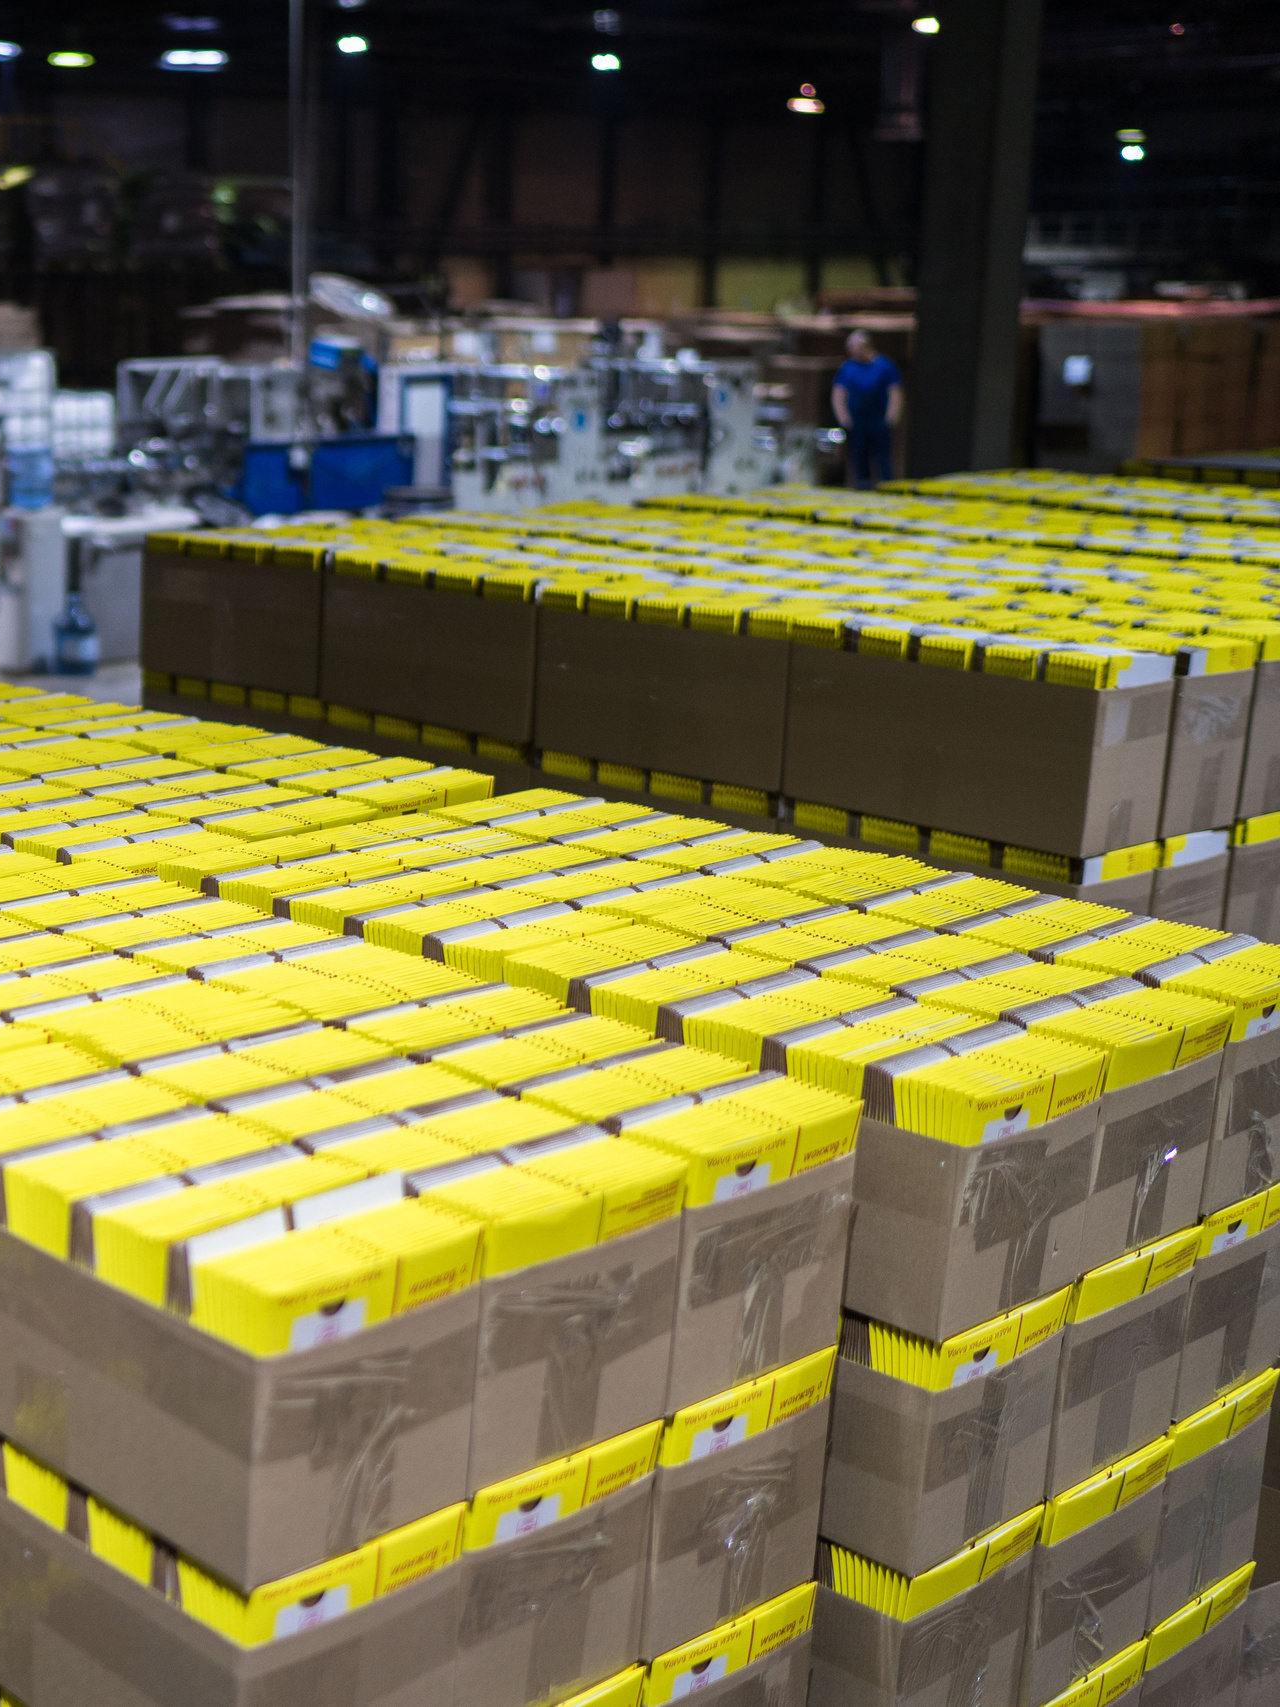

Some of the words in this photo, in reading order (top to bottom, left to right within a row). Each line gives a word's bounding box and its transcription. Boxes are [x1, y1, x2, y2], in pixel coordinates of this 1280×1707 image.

[400, 800, 421, 809] ВТОРЫХ
[1026, 1085, 1045, 1098] ИДЕИ
[1088, 1086, 1093, 1094] о
[1000, 1092, 1024, 1105] ВТОРЫХ
[1057, 1088, 1087, 1109] важном
[977, 1101, 998, 1111] БЛЮД
[765, 1138, 786, 1153] ИДЕИ
[842, 1138, 847, 1147] о
[734, 1144, 763, 1160] ВТОРЫХ
[803, 1140, 840, 1162] важном
[707, 1155, 731, 1167] БЛЮД
[1053, 1318, 1058, 1326] о
[994, 1326, 1012, 1339] ИДЕИ
[1024, 1322, 1052, 1344] важном
[969, 1333, 993, 1349] ВТОРЫХ
[947, 1345, 968, 1358] БЛЮД
[817, 1381, 822, 1390] о
[742, 1390, 762, 1403] ИДЕИ
[779, 1385, 815, 1410] важном
[710, 1401, 739, 1418] ВТОРЫХ
[684, 1413, 708, 1426] БЛЮД
[640, 1456, 646, 1465] о
[552, 1468, 576, 1483] ИДЕИ
[597, 1461, 637, 1487] важном
[799, 1615, 804, 1624] о
[720, 1630, 742, 1645] ИДЕИ
[761, 1620, 796, 1647] важном
[689, 1642, 718, 1659] ВТОРЫХ
[664, 1657, 687, 1670] БЛЮД
